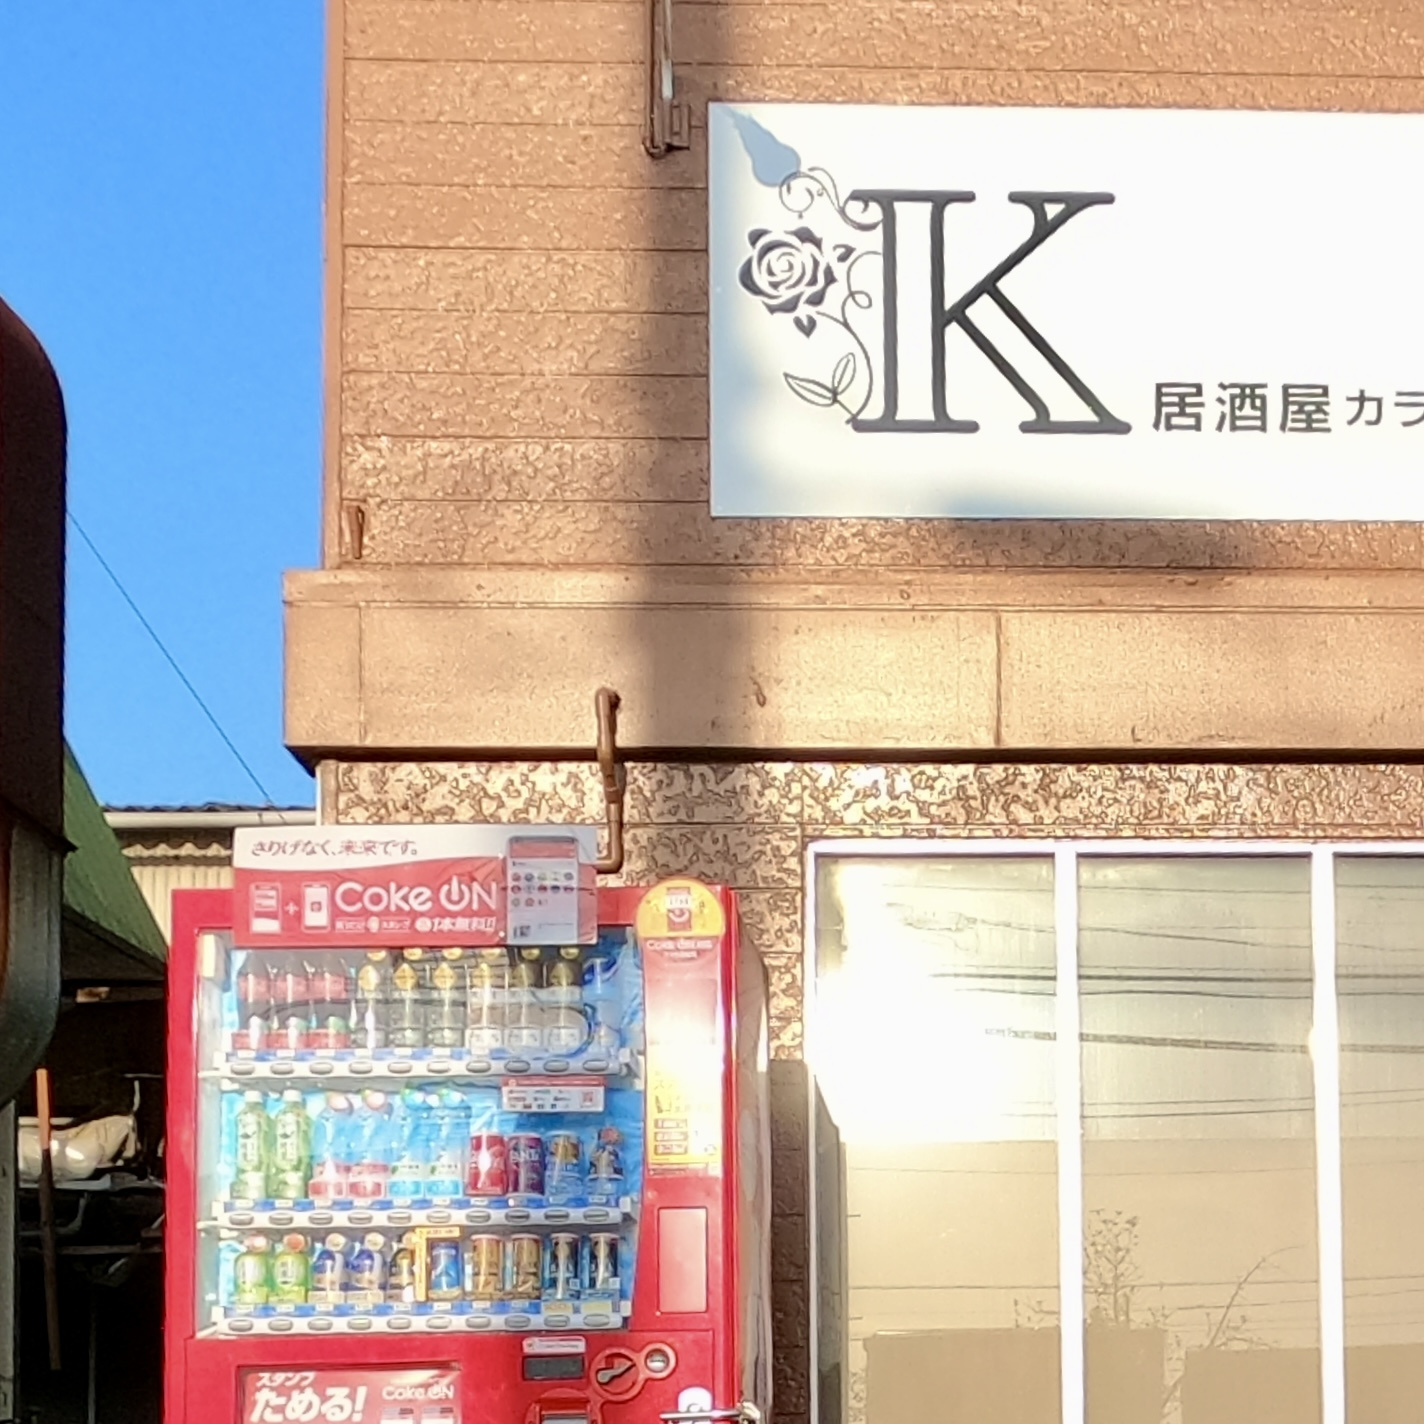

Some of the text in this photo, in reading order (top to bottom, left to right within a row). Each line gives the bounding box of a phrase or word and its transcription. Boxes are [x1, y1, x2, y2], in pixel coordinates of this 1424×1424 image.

[844, 188, 1132, 435] K
[334, 875, 498, 913] Coke ON
[250, 1386, 368, 1423] ためる!
